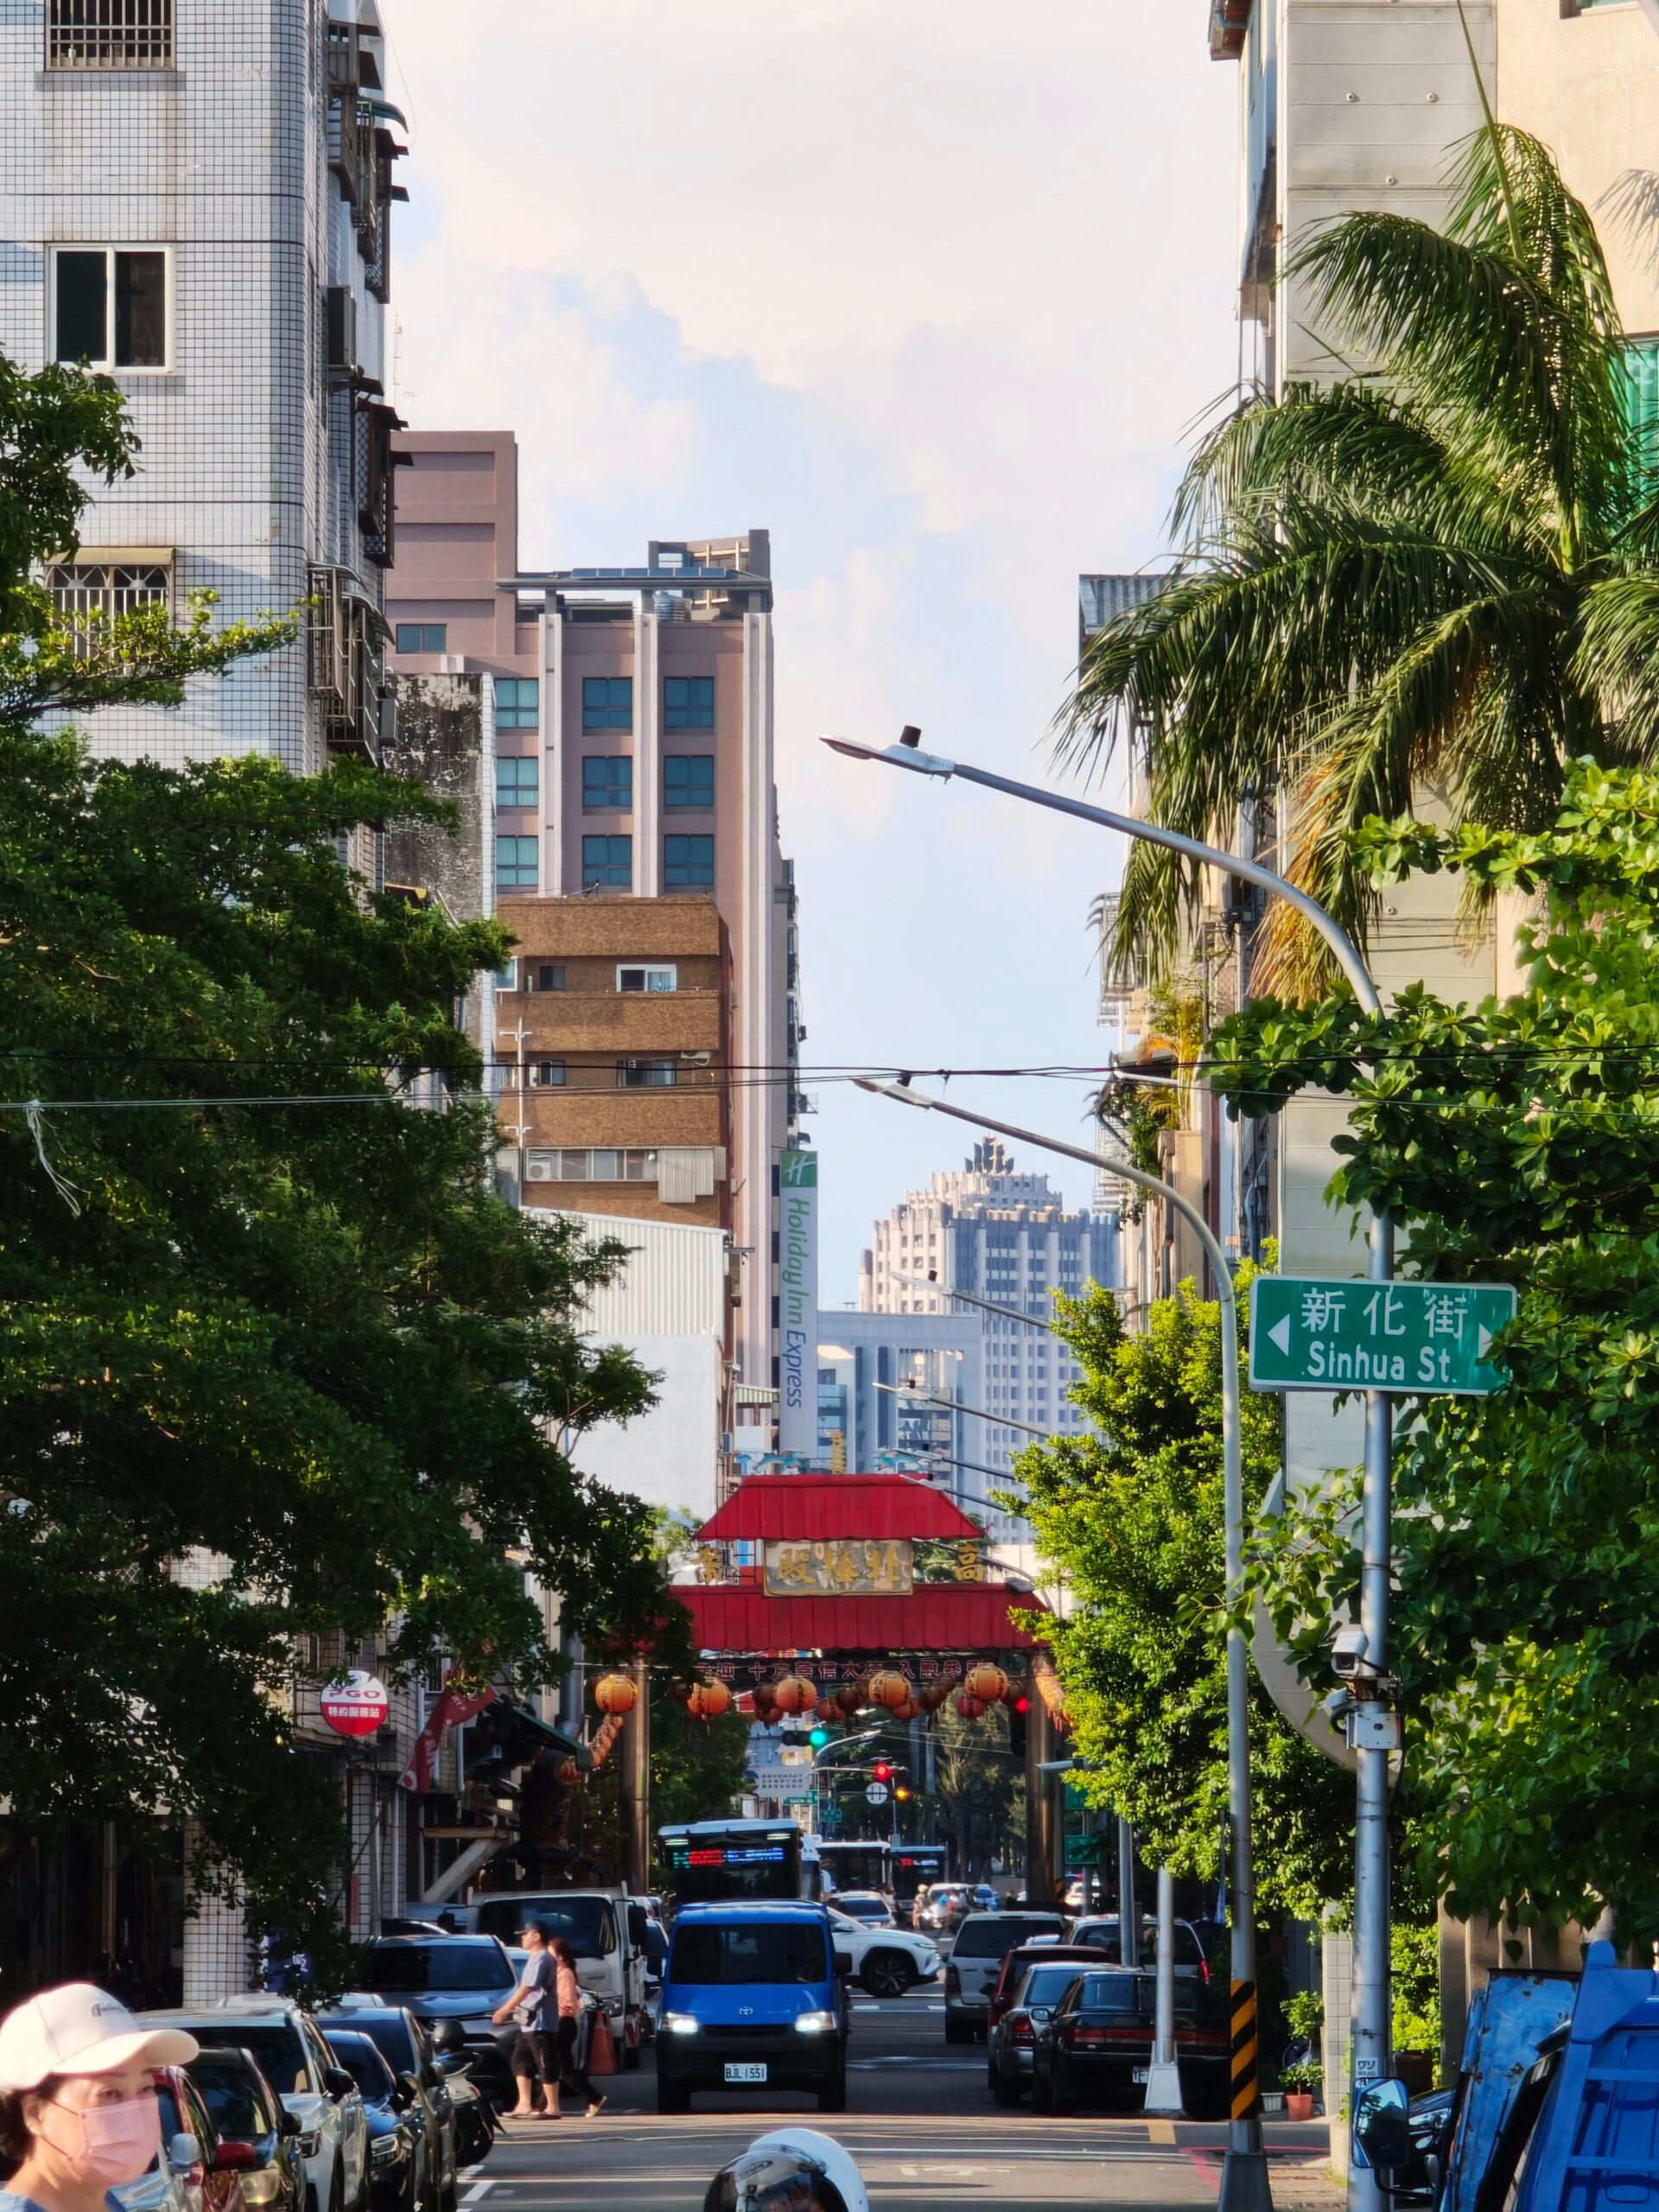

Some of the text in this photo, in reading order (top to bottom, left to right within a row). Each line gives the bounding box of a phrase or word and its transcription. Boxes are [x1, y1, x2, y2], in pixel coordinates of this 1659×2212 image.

[783, 1197, 810, 1408] Holiday Inn Express
[1300, 1286, 1468, 1339] 新化街
[1306, 1341, 1405, 1381] Sinhua
[327, 1706, 380, 1719] 特約服務站
[329, 1688, 381, 1699] PGO
